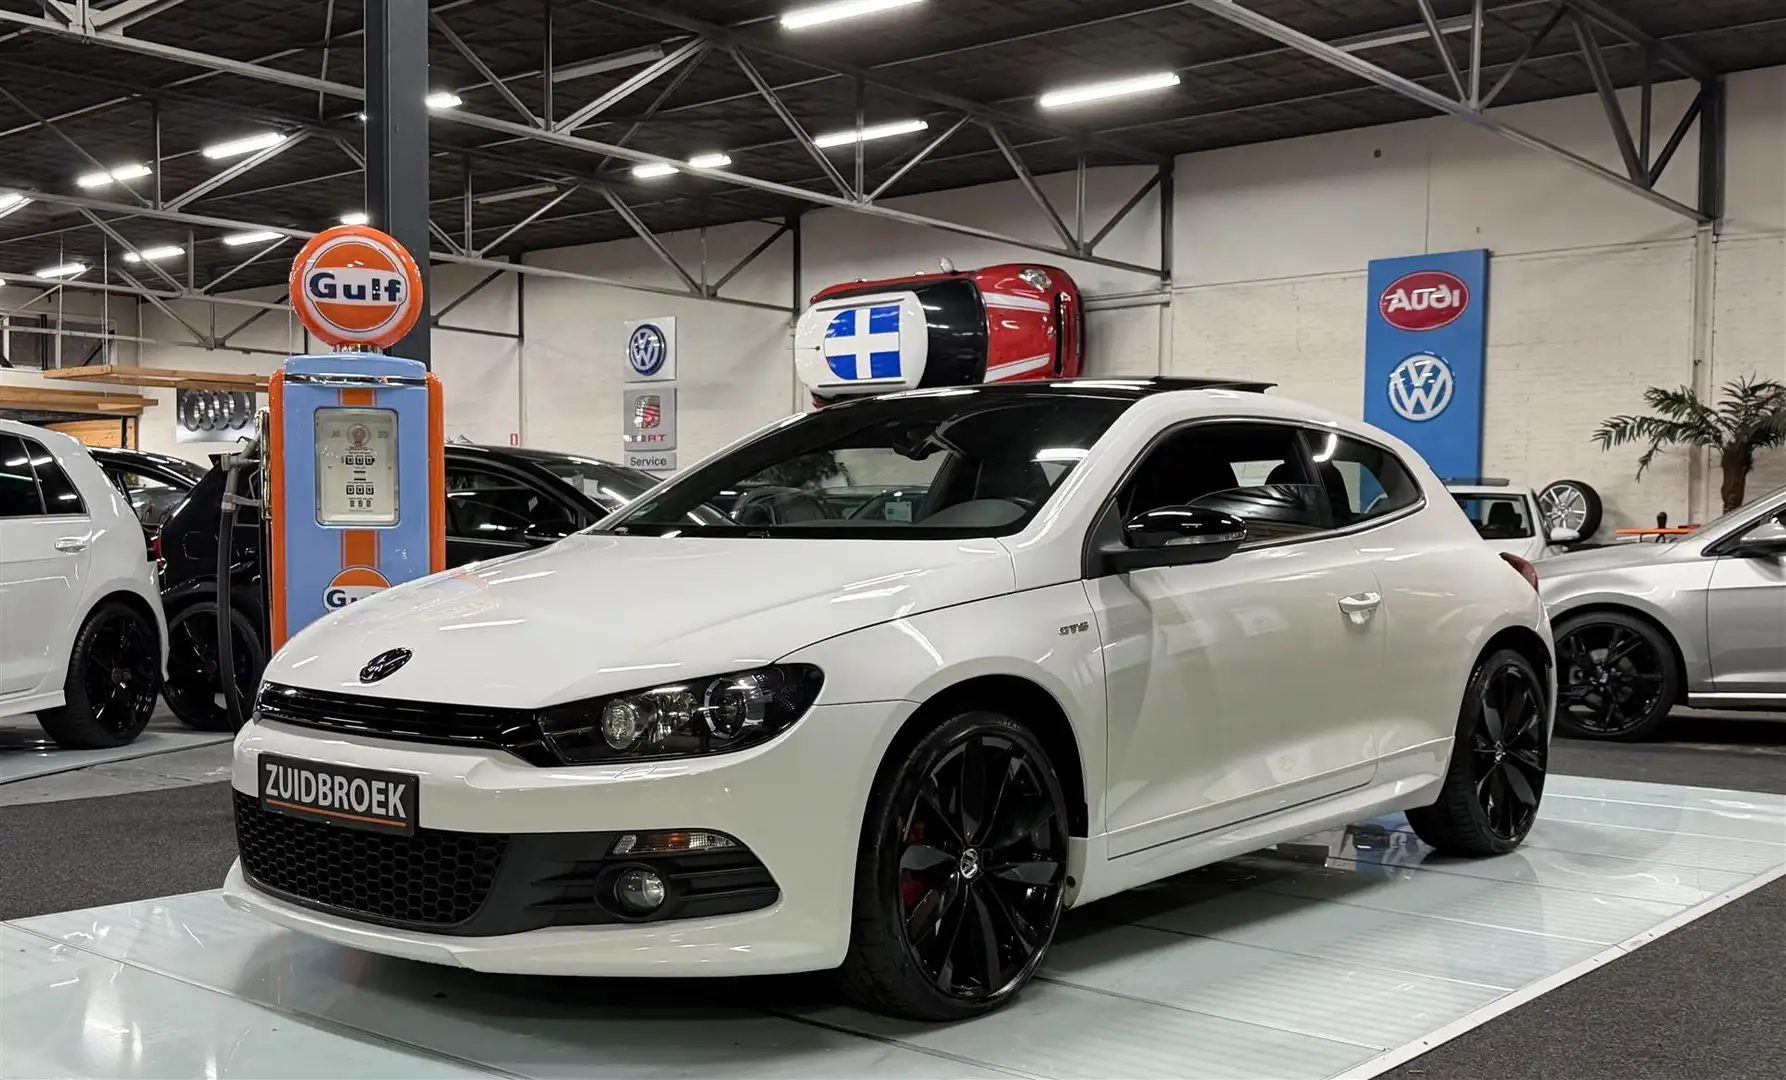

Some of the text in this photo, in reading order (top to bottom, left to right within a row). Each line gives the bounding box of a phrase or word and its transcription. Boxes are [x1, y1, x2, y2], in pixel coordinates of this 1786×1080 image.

[309, 272, 402, 302] Gulf
[629, 456, 667, 467] Service
[265, 763, 407, 819] ZUIDBROEK
